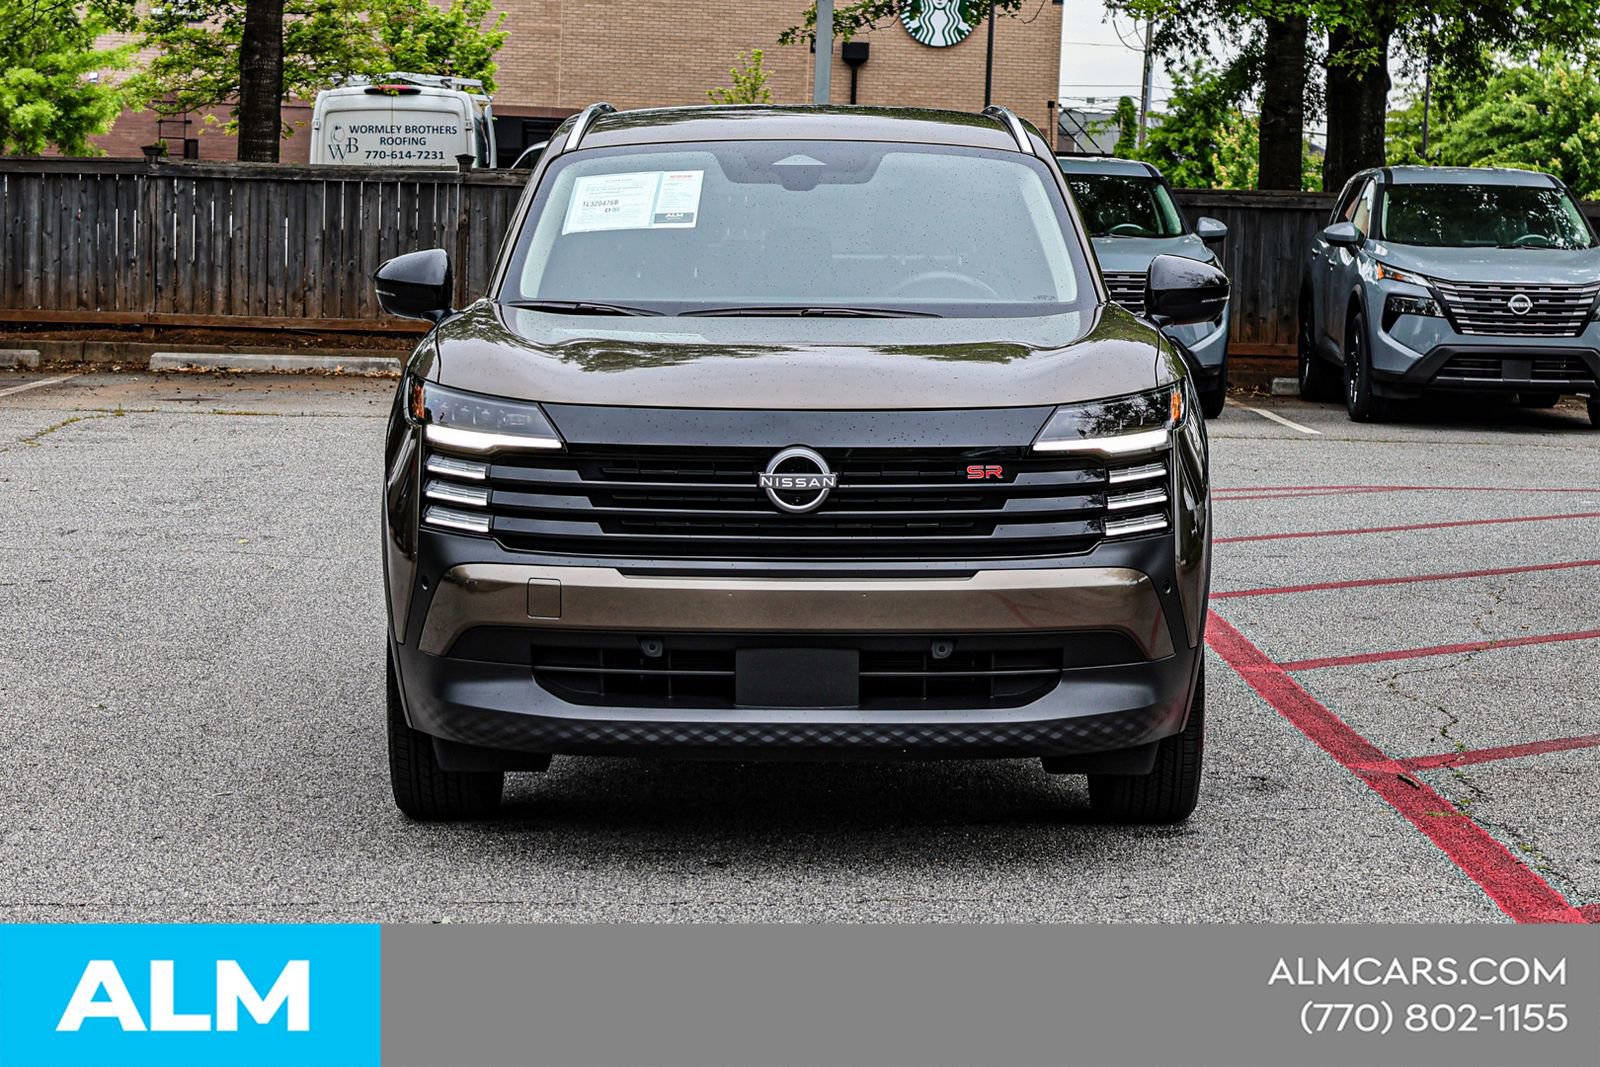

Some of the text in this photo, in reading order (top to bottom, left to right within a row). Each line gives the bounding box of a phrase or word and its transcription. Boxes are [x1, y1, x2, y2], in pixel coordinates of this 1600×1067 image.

[349, 125, 457, 134] WORMLEY BROTHERS
[380, 137, 426, 146] ROOFING
[365, 150, 444, 160] 770-614-7231
[967, 465, 1003, 479] SR
[760, 476, 836, 488] NISSAN
